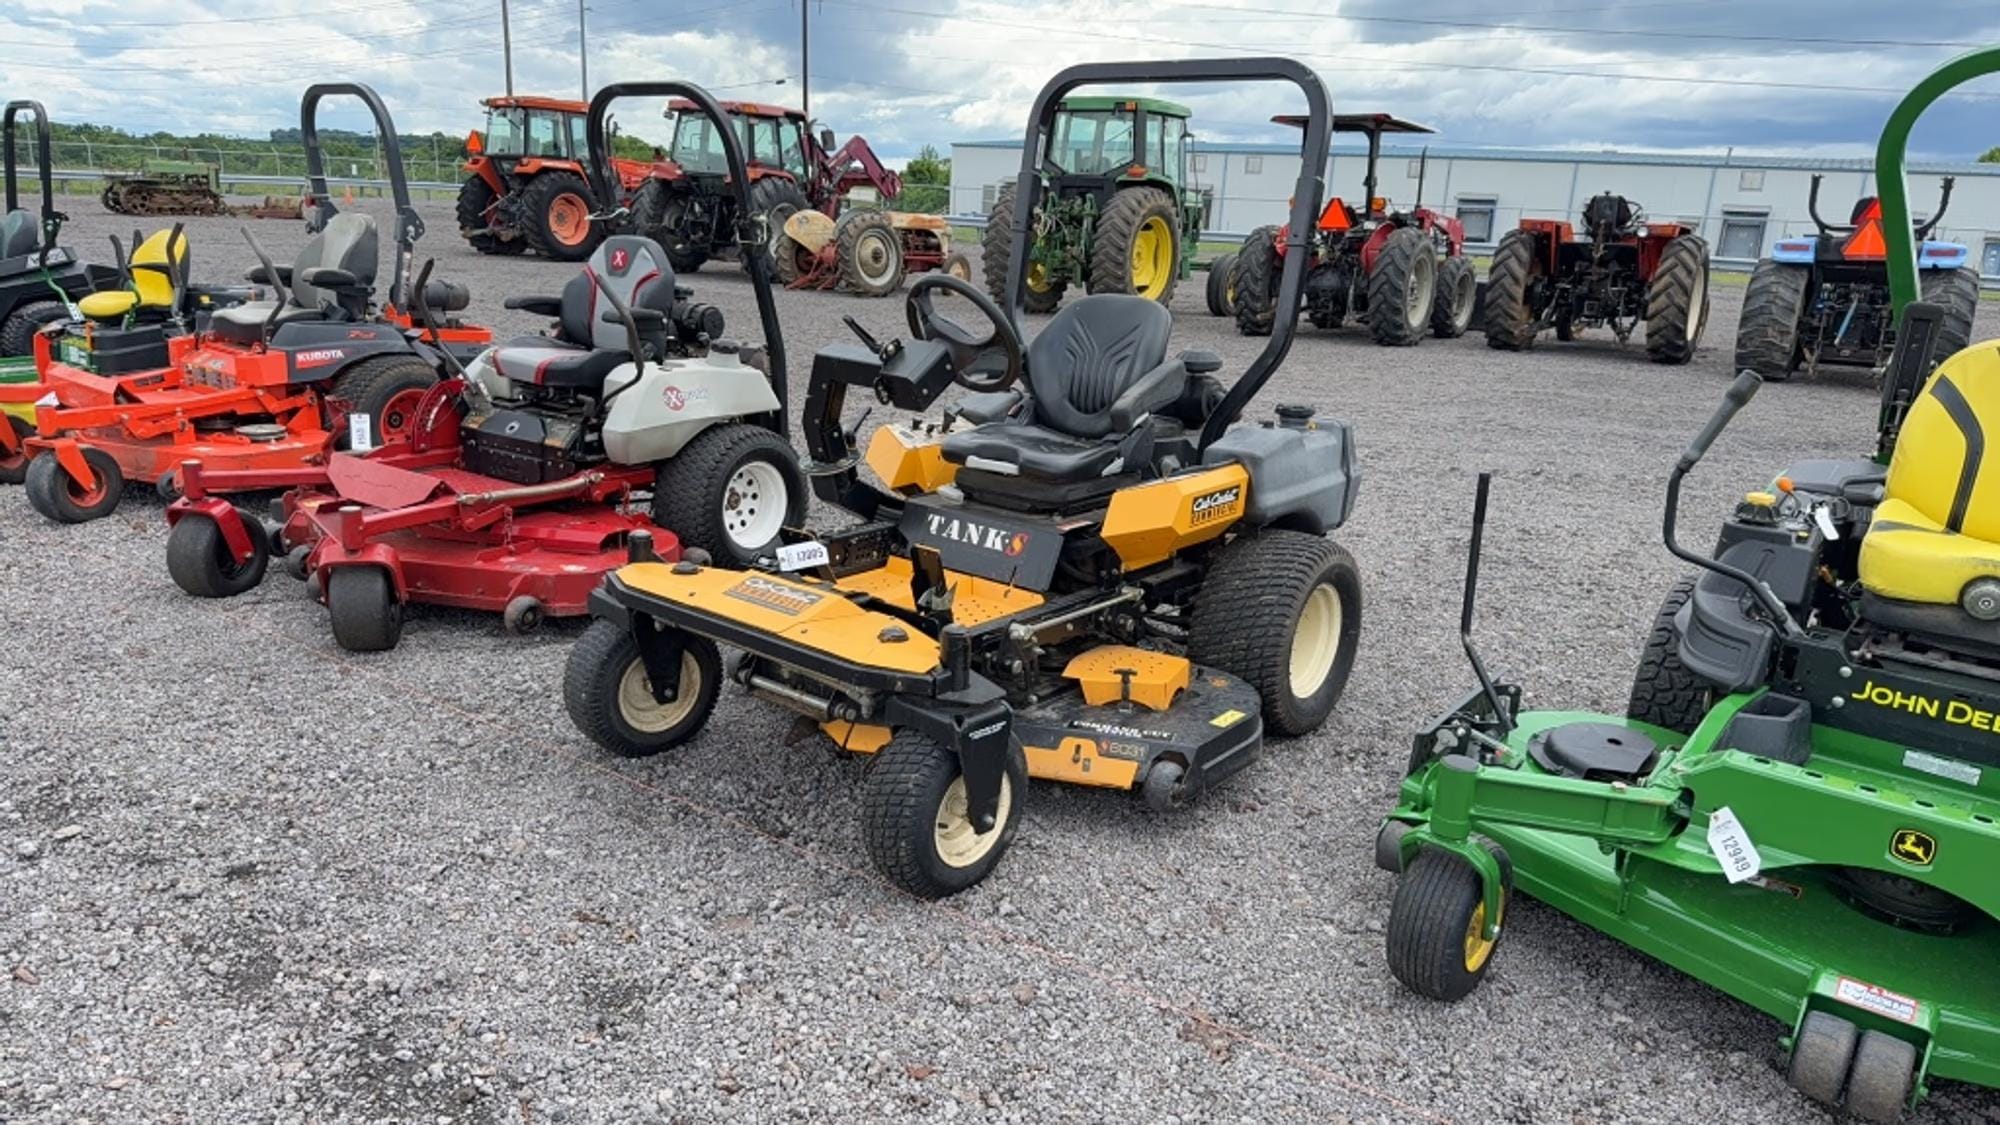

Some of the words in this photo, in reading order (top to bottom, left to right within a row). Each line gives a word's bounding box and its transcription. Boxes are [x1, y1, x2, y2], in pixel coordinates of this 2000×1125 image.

[295, 348, 345, 362] KUBOTA
[1851, 680, 1940, 718] JOHN
[1721, 835, 1751, 872] 12949
